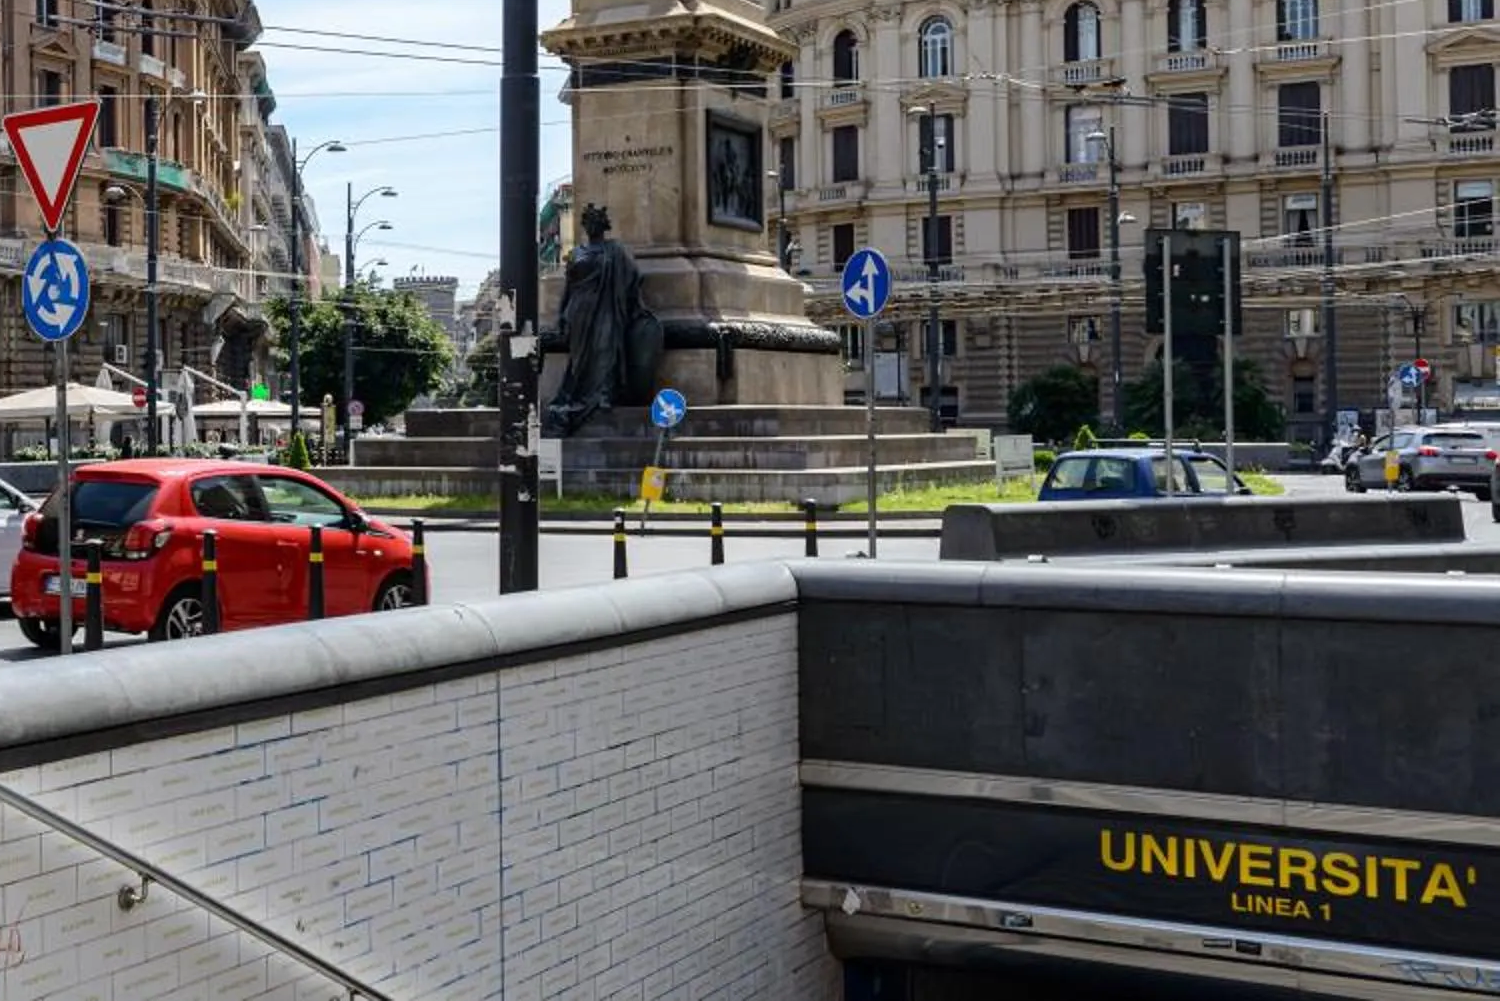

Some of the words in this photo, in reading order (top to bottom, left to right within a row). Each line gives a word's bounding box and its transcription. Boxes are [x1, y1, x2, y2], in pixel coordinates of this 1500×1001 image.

[1101, 828, 1477, 908] UNIVERSITA'
[1231, 891, 1312, 920] LINEA
[1319, 902, 1332, 921] 1
